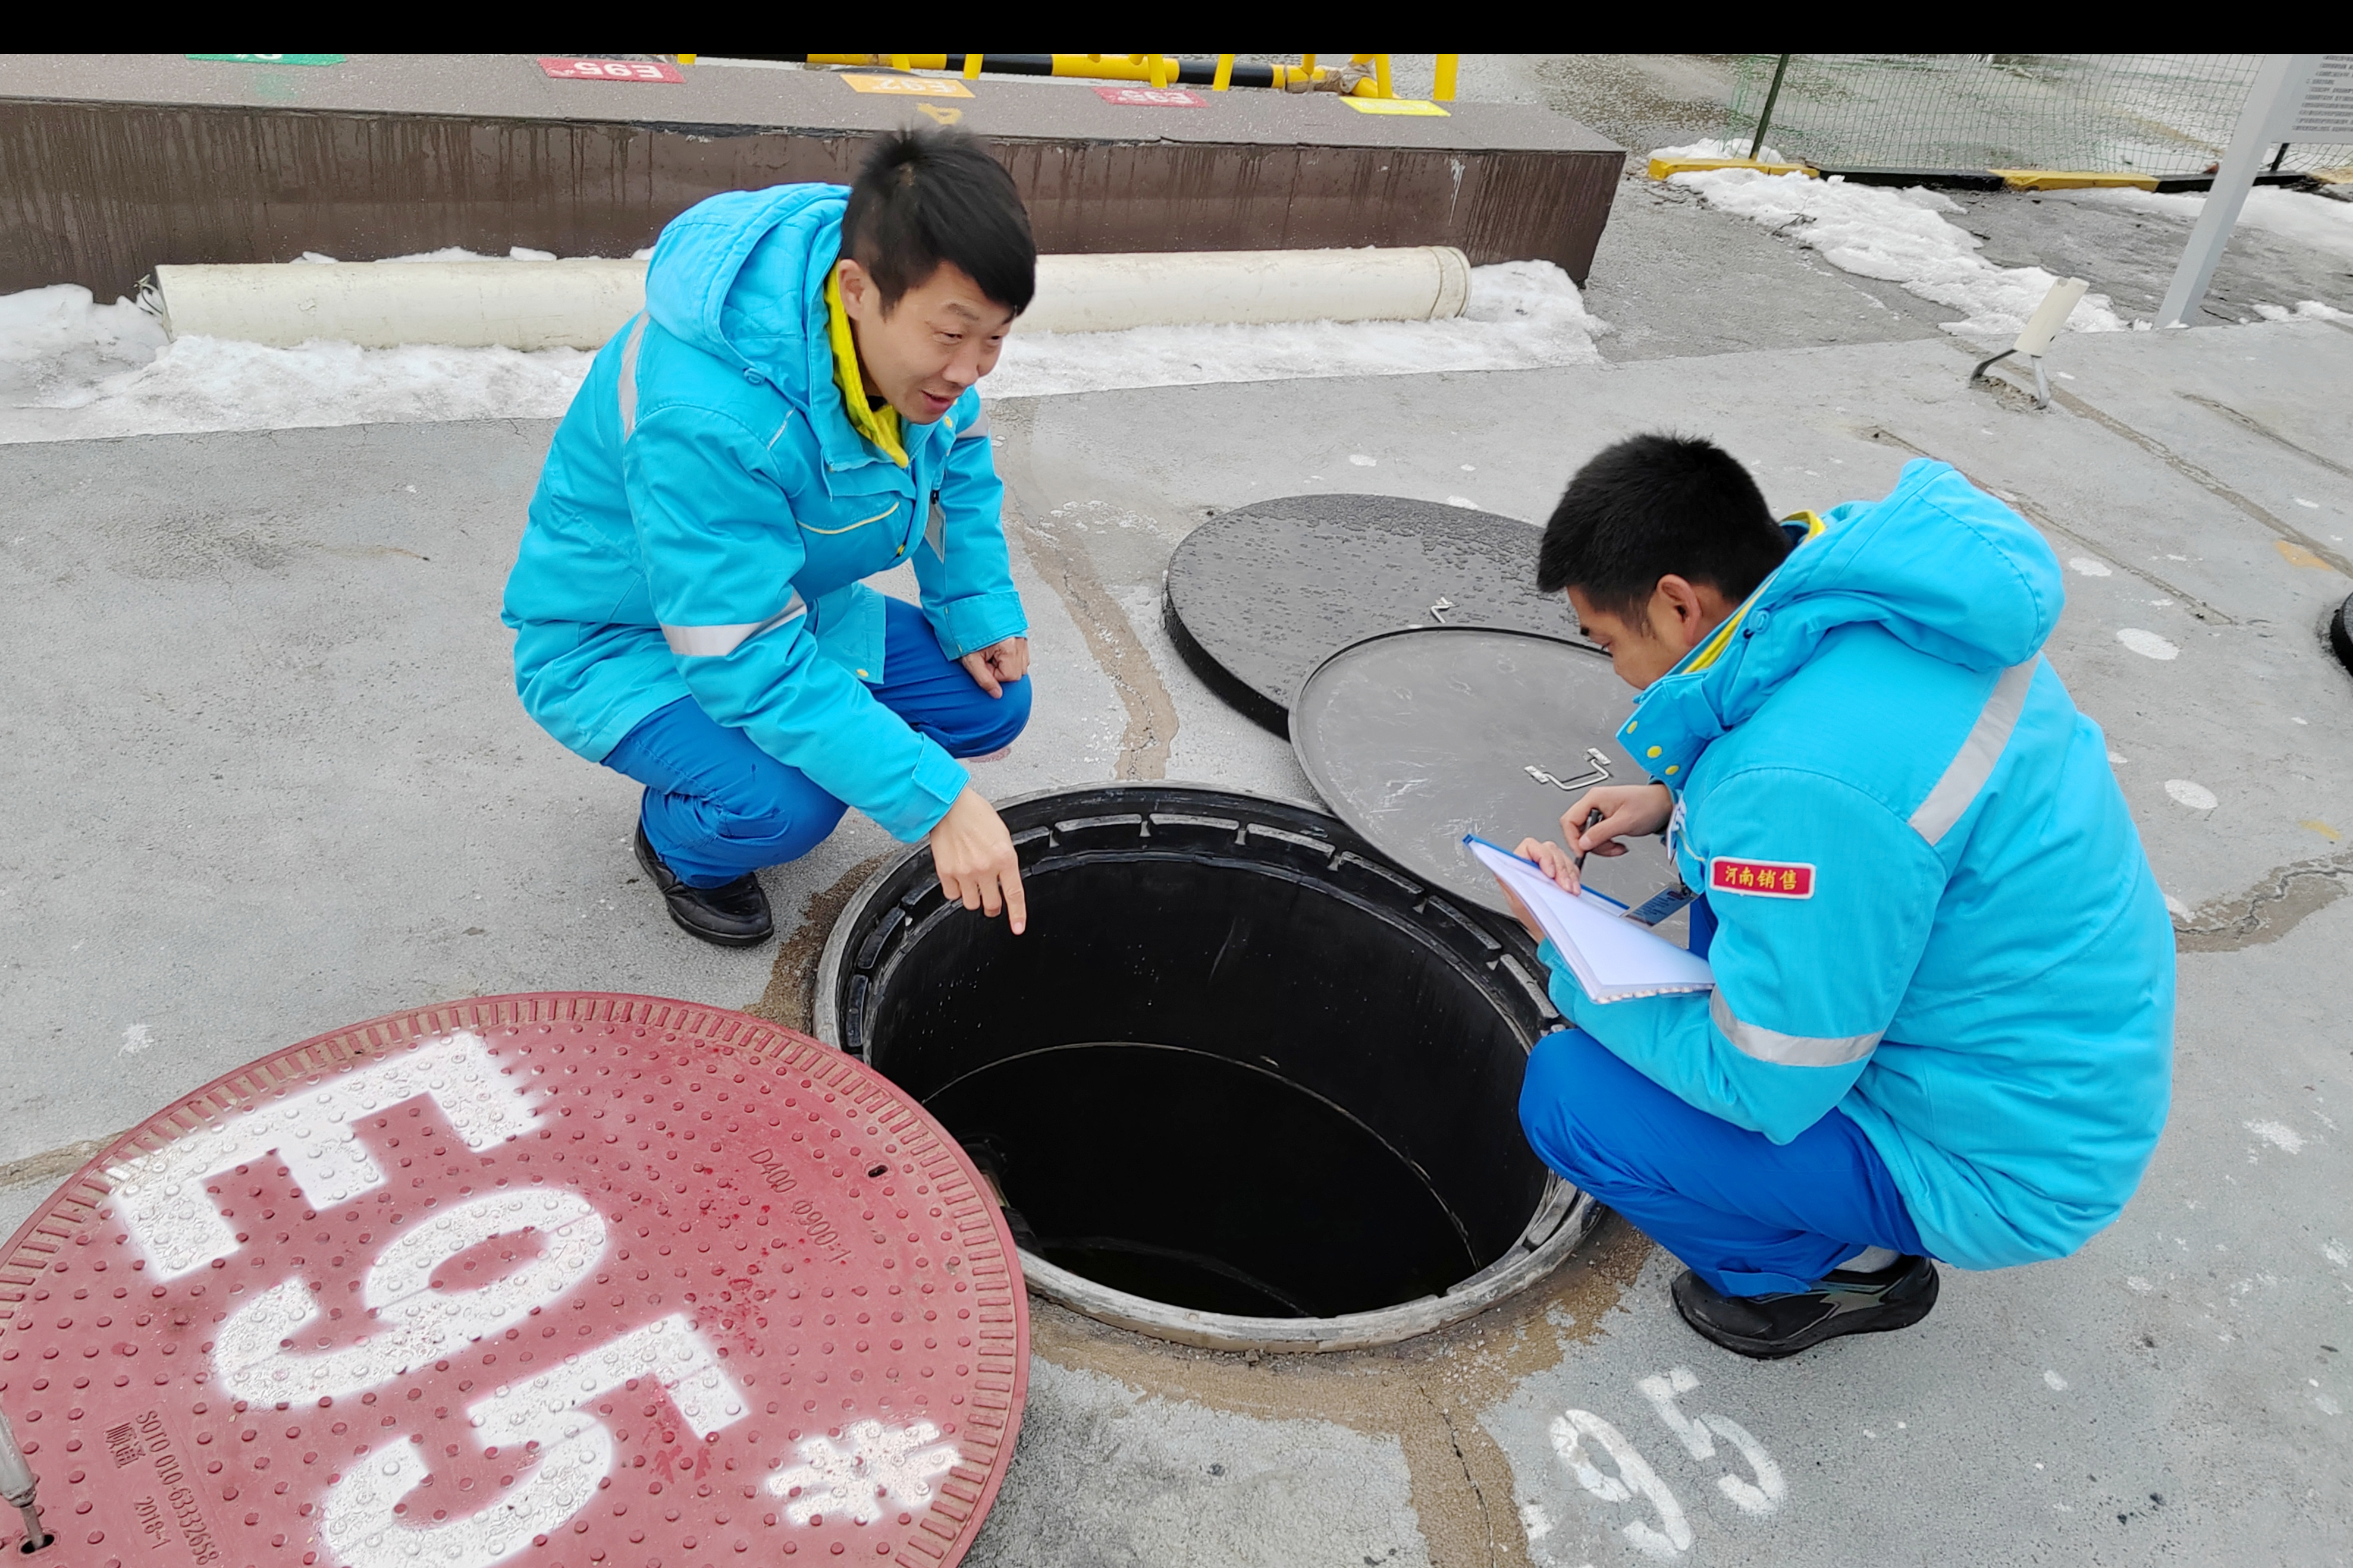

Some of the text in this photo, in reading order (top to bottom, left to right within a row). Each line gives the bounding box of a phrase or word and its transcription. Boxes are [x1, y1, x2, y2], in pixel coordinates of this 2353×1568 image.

[1725, 865, 1797, 890] 河南销售
[748, 1148, 797, 1193] D400
[105, 1422, 146, 1469] 顺通
[1549, 1369, 1787, 1558] 95
[136, 1410, 219, 1566] SOTO 010-63332658
[134, 1496, 171, 1550] 2018-1
